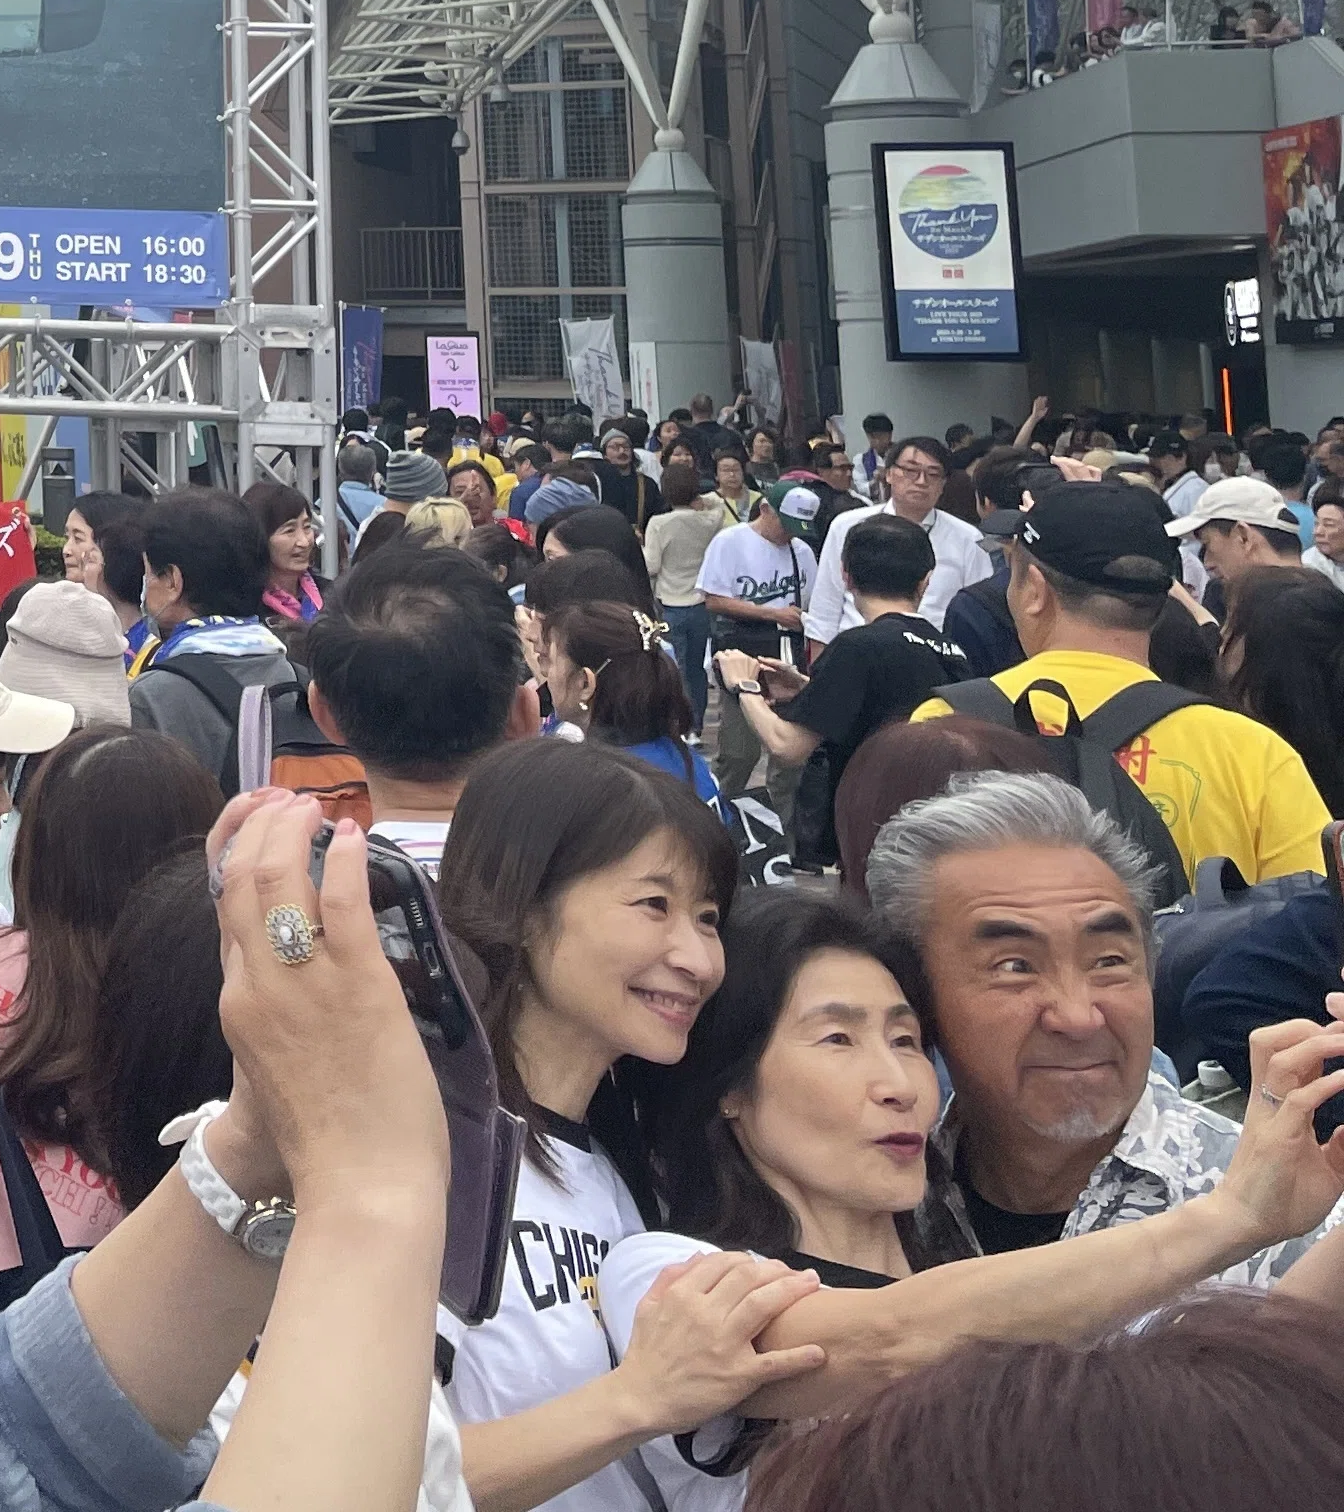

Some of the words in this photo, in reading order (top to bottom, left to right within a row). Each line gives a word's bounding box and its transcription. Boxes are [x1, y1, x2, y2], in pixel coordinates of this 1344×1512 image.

[55, 234, 121, 255] OPEN
[142, 236, 205, 257] 16:00
[55, 261, 131, 282] START
[142, 264, 206, 285] 18:30
